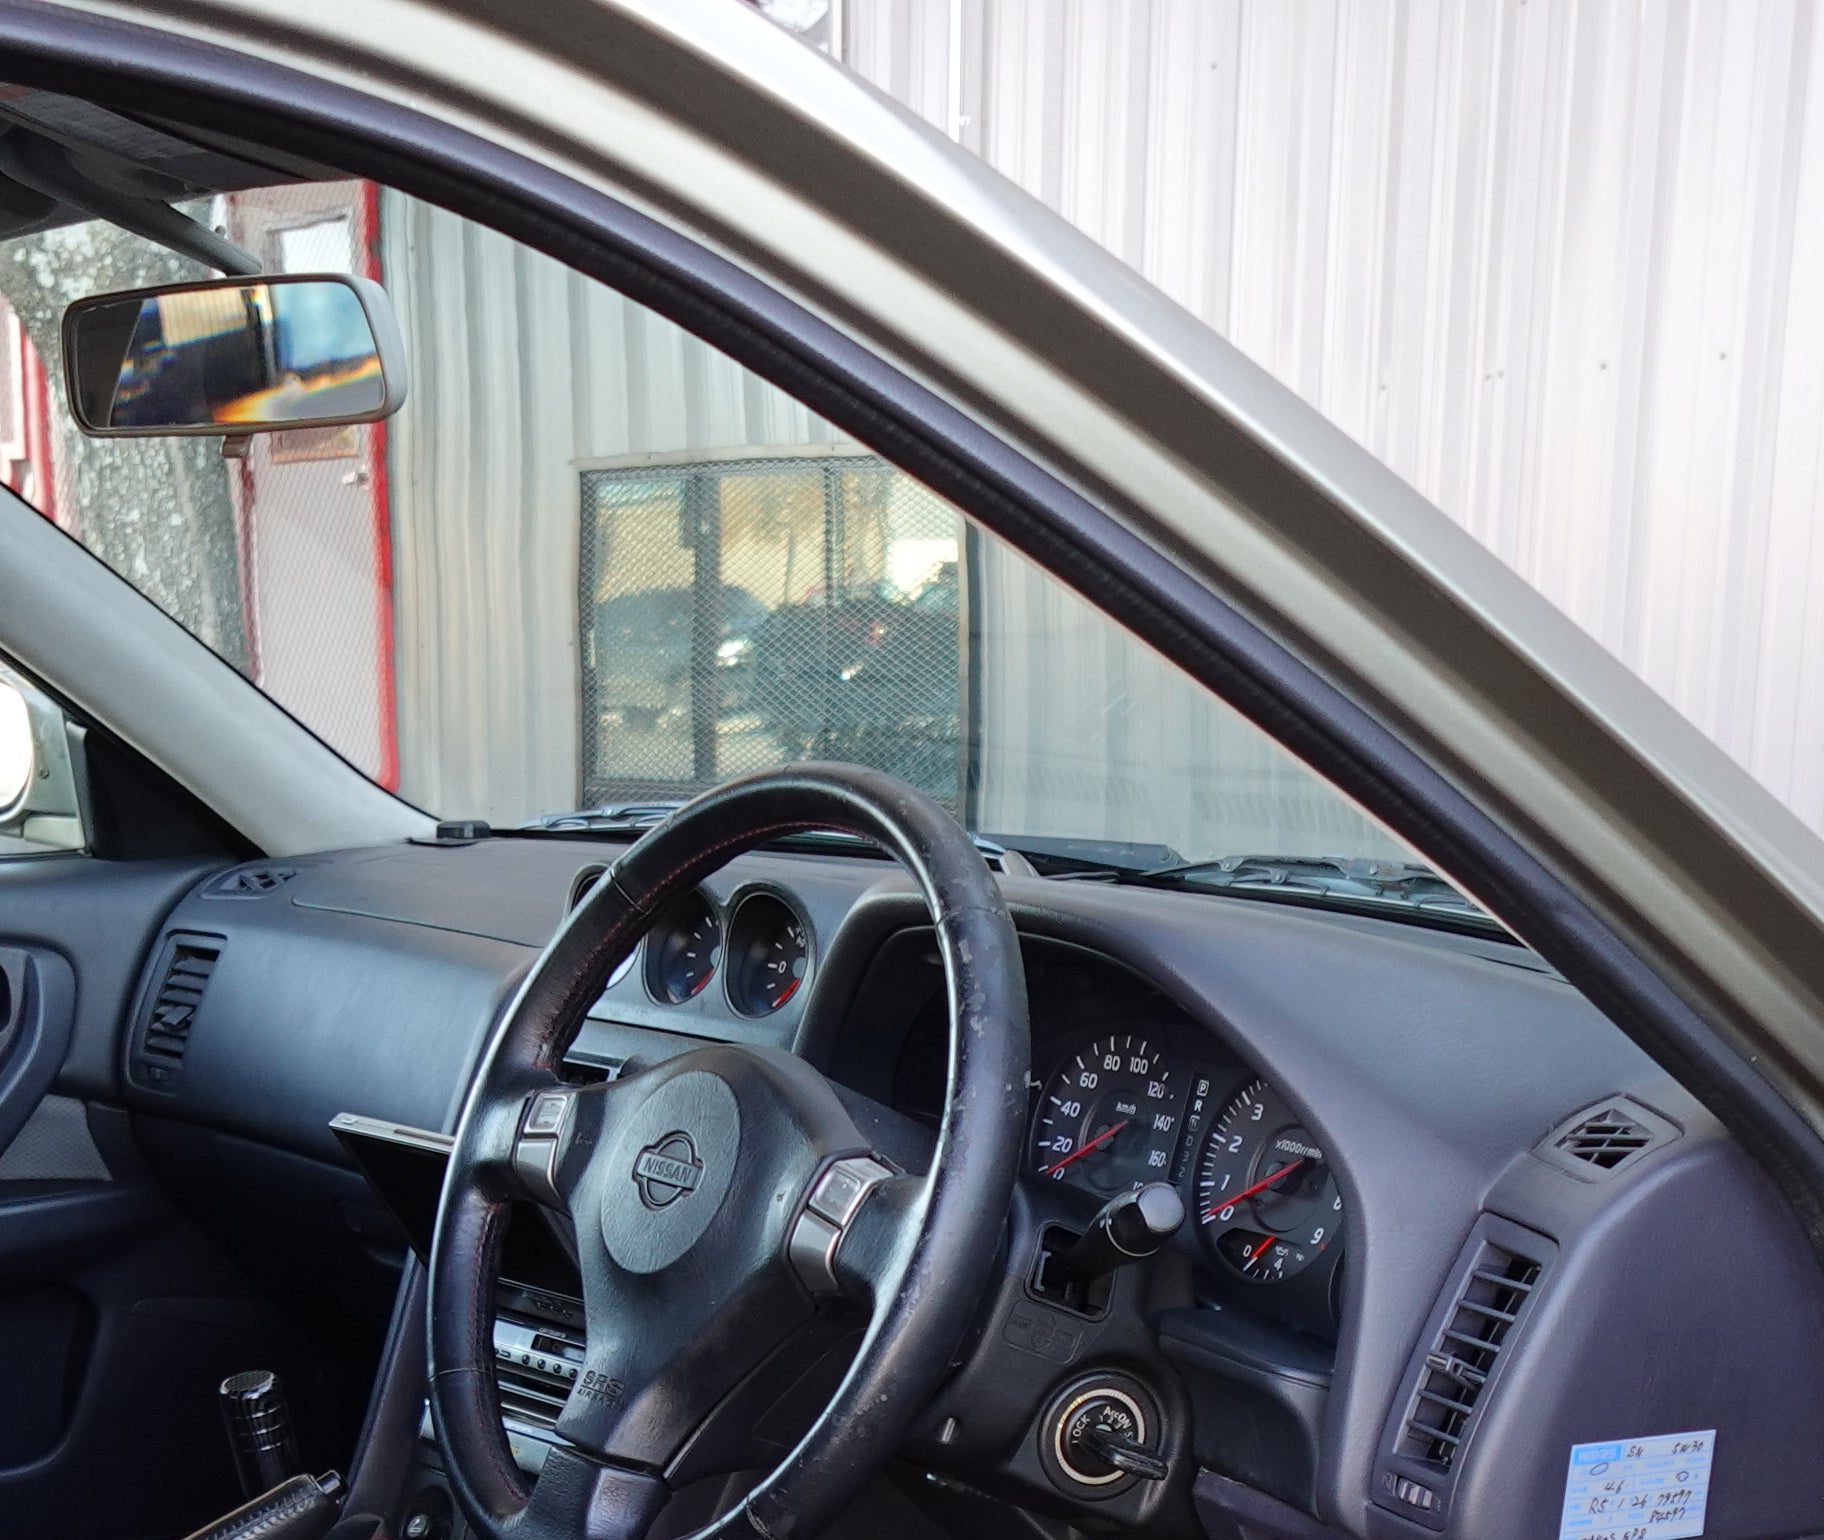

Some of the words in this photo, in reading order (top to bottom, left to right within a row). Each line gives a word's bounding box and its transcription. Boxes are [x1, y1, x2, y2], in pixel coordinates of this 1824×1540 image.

[1103, 1054, 1121, 1072] 80
[1129, 1056, 1149, 1075] 100
[1079, 1072, 1098, 1089] 60
[1147, 1080, 1165, 1099] 120
[1060, 1100, 1081, 1118] 40
[1194, 1099, 1203, 1112] R
[1250, 1103, 1265, 1121] 3
[1152, 1114, 1172, 1132] 140
[1052, 1136, 1073, 1154] 20
[1186, 1135, 1194, 1147] D
[1228, 1135, 1243, 1153] 2
[1147, 1149, 1166, 1168] 160
[643, 1158, 693, 1183] NISSAN
[1052, 1167, 1065, 1181] 0
[1220, 1174, 1231, 1191] 1
[1219, 1204, 1235, 1221] 0
[1310, 1227, 1325, 1245] 9
[1242, 1244, 1253, 1258] 0
[1273, 1258, 1283, 1271] 4
[583, 1370, 625, 1397] SRS
[1072, 1414, 1091, 1444] LOCK
[1118, 1413, 1132, 1429] ON
